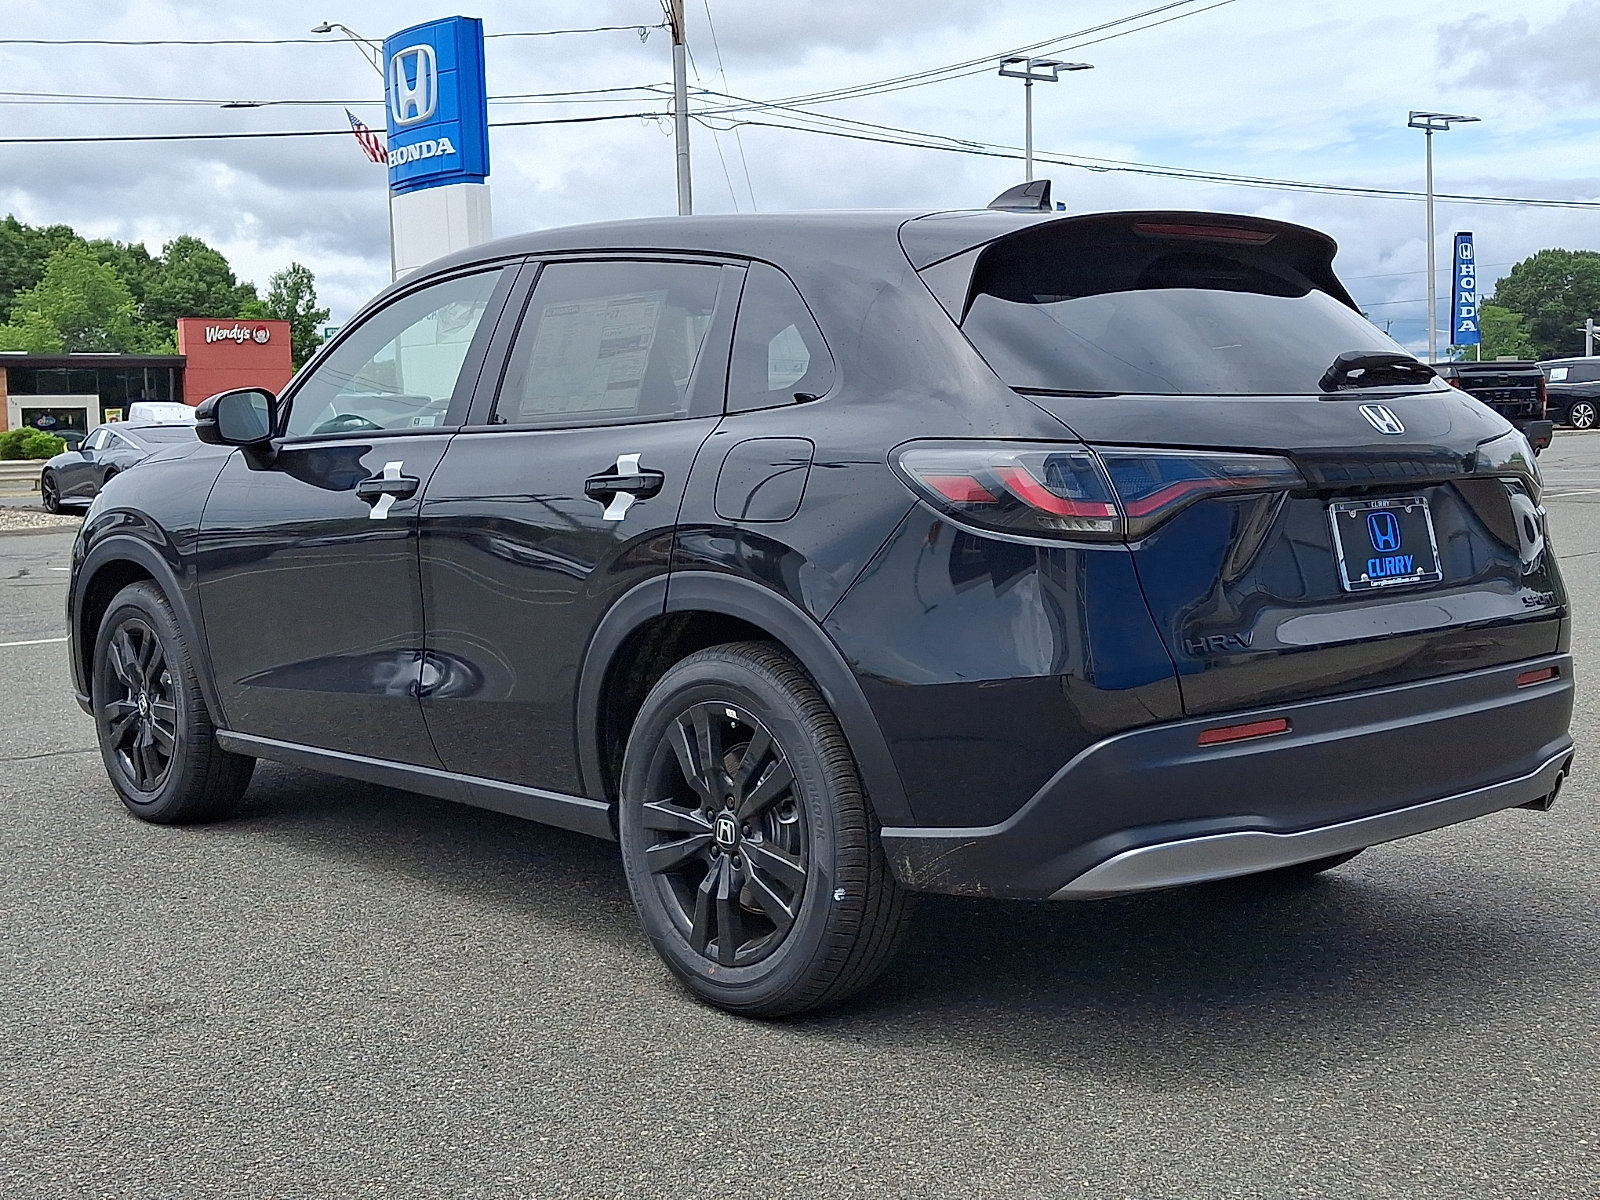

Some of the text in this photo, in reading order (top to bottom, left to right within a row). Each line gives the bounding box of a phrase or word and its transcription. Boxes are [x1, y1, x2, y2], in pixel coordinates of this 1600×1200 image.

[388, 138, 456, 169] HONDA
[1458, 264, 1477, 332] HONDA
[205, 324, 251, 343] Wendy's
[1367, 555, 1413, 578] CURRY
[1521, 591, 1555, 608] SPORT
[1184, 630, 1254, 656] HR-V
